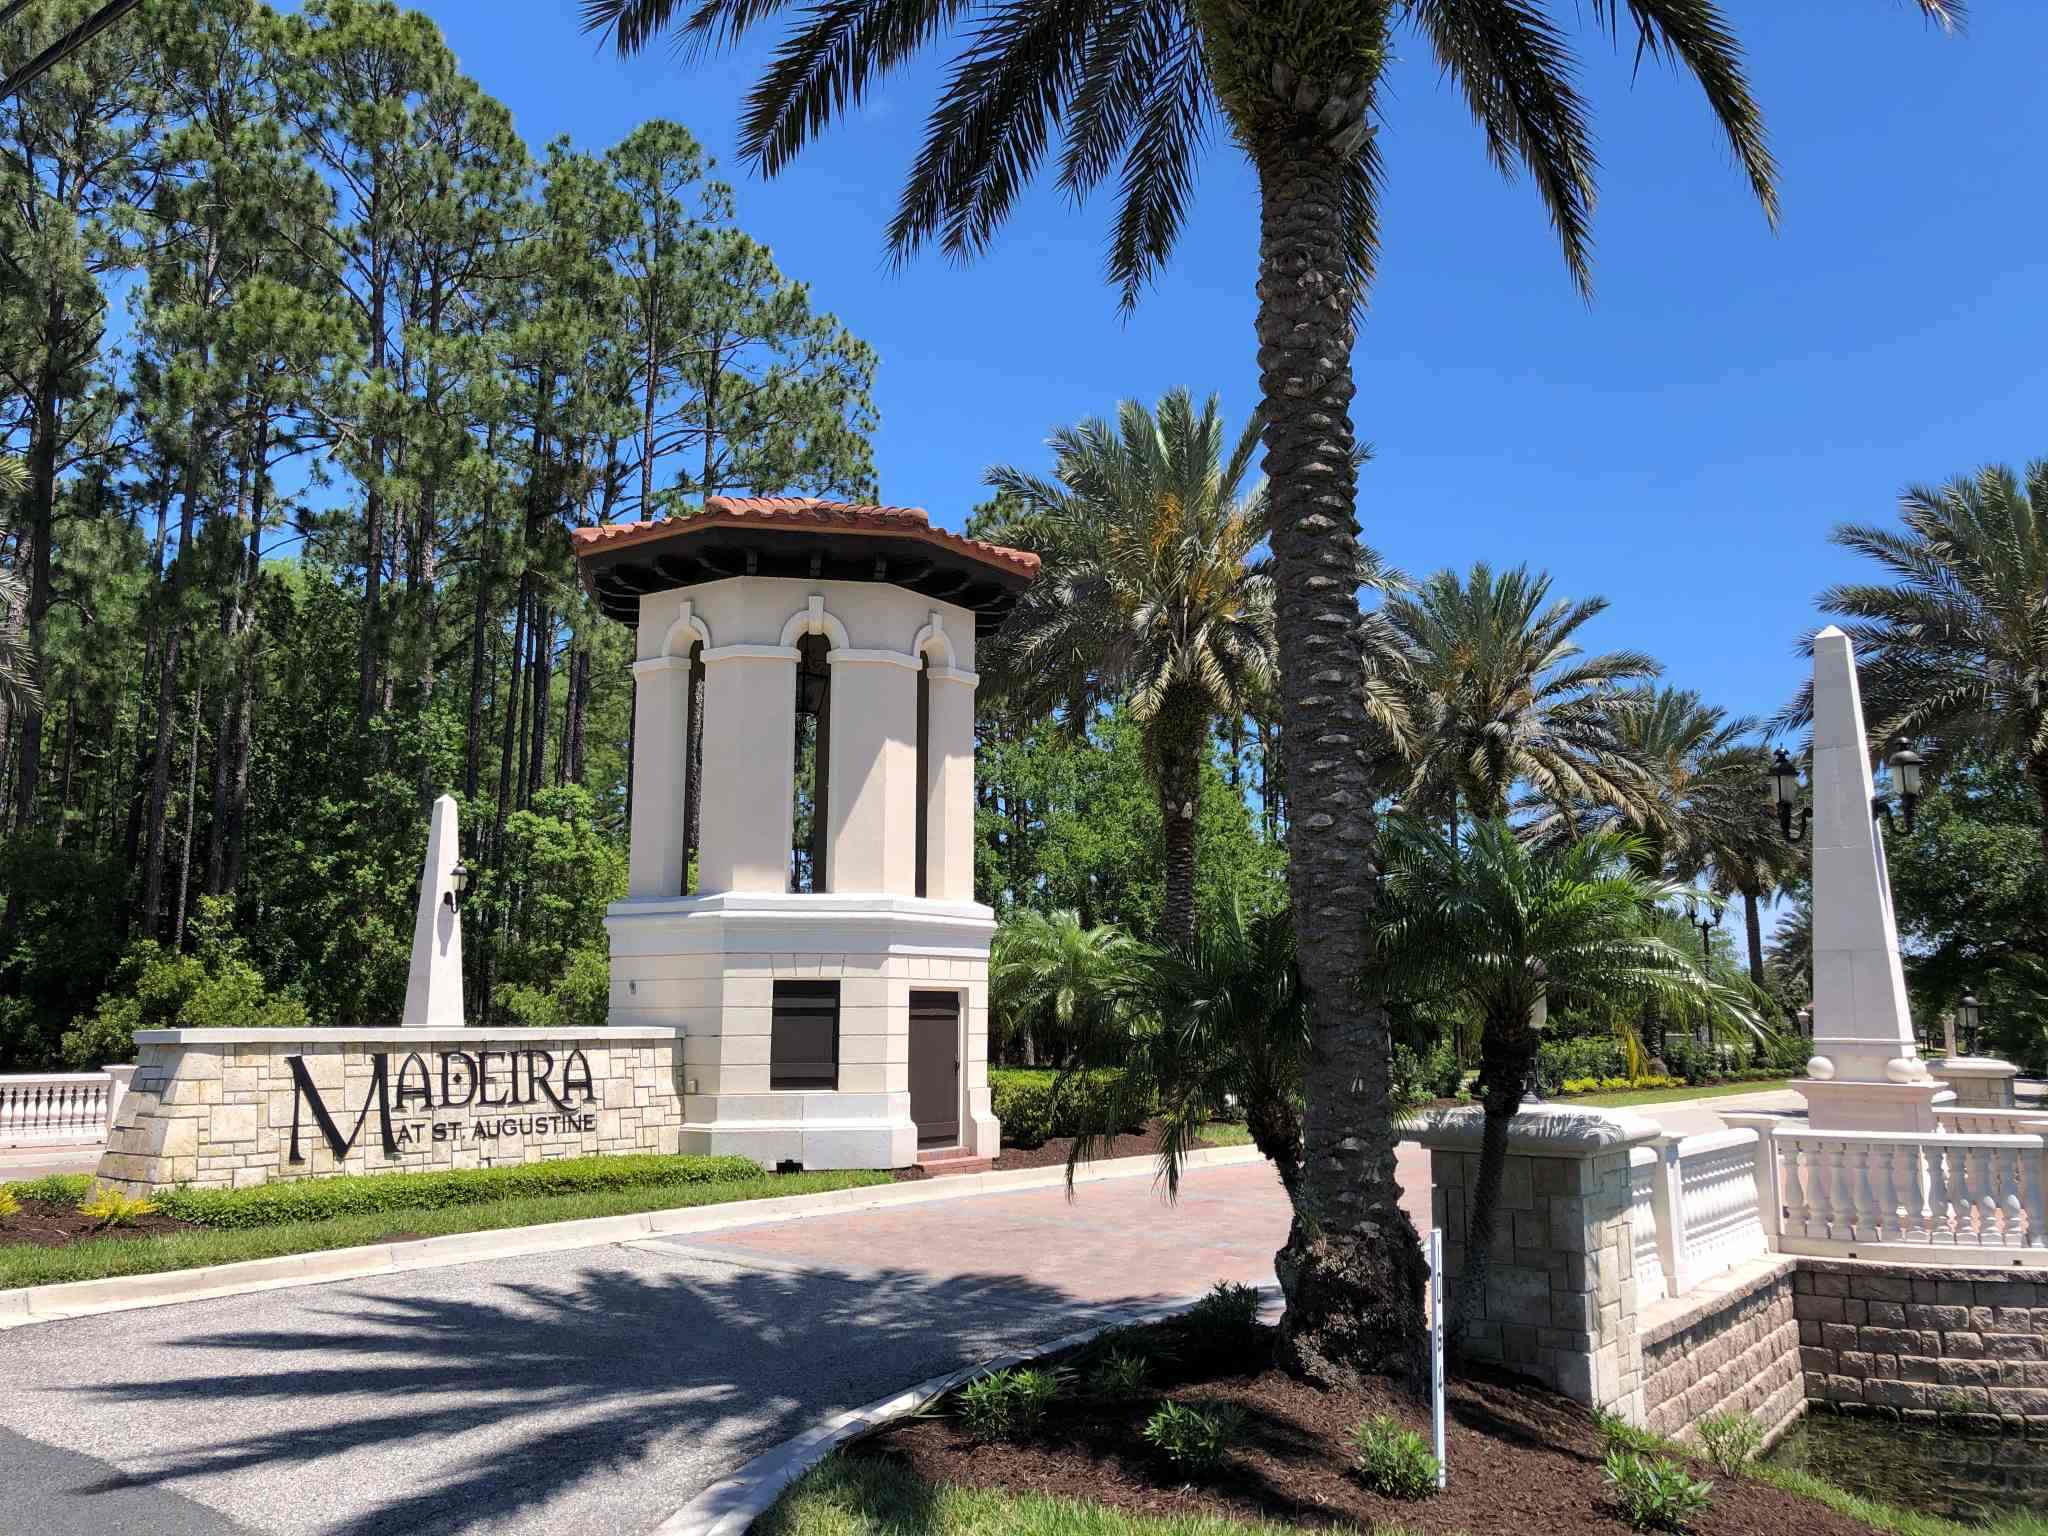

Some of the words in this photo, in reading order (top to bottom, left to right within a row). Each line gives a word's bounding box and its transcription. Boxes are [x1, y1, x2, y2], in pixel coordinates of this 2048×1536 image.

[287, 1049, 597, 1163] MADEIRA
[397, 1123, 425, 1144] AT
[431, 1121, 466, 1142] ST.
[471, 1114, 596, 1141] AUGUSTINE
